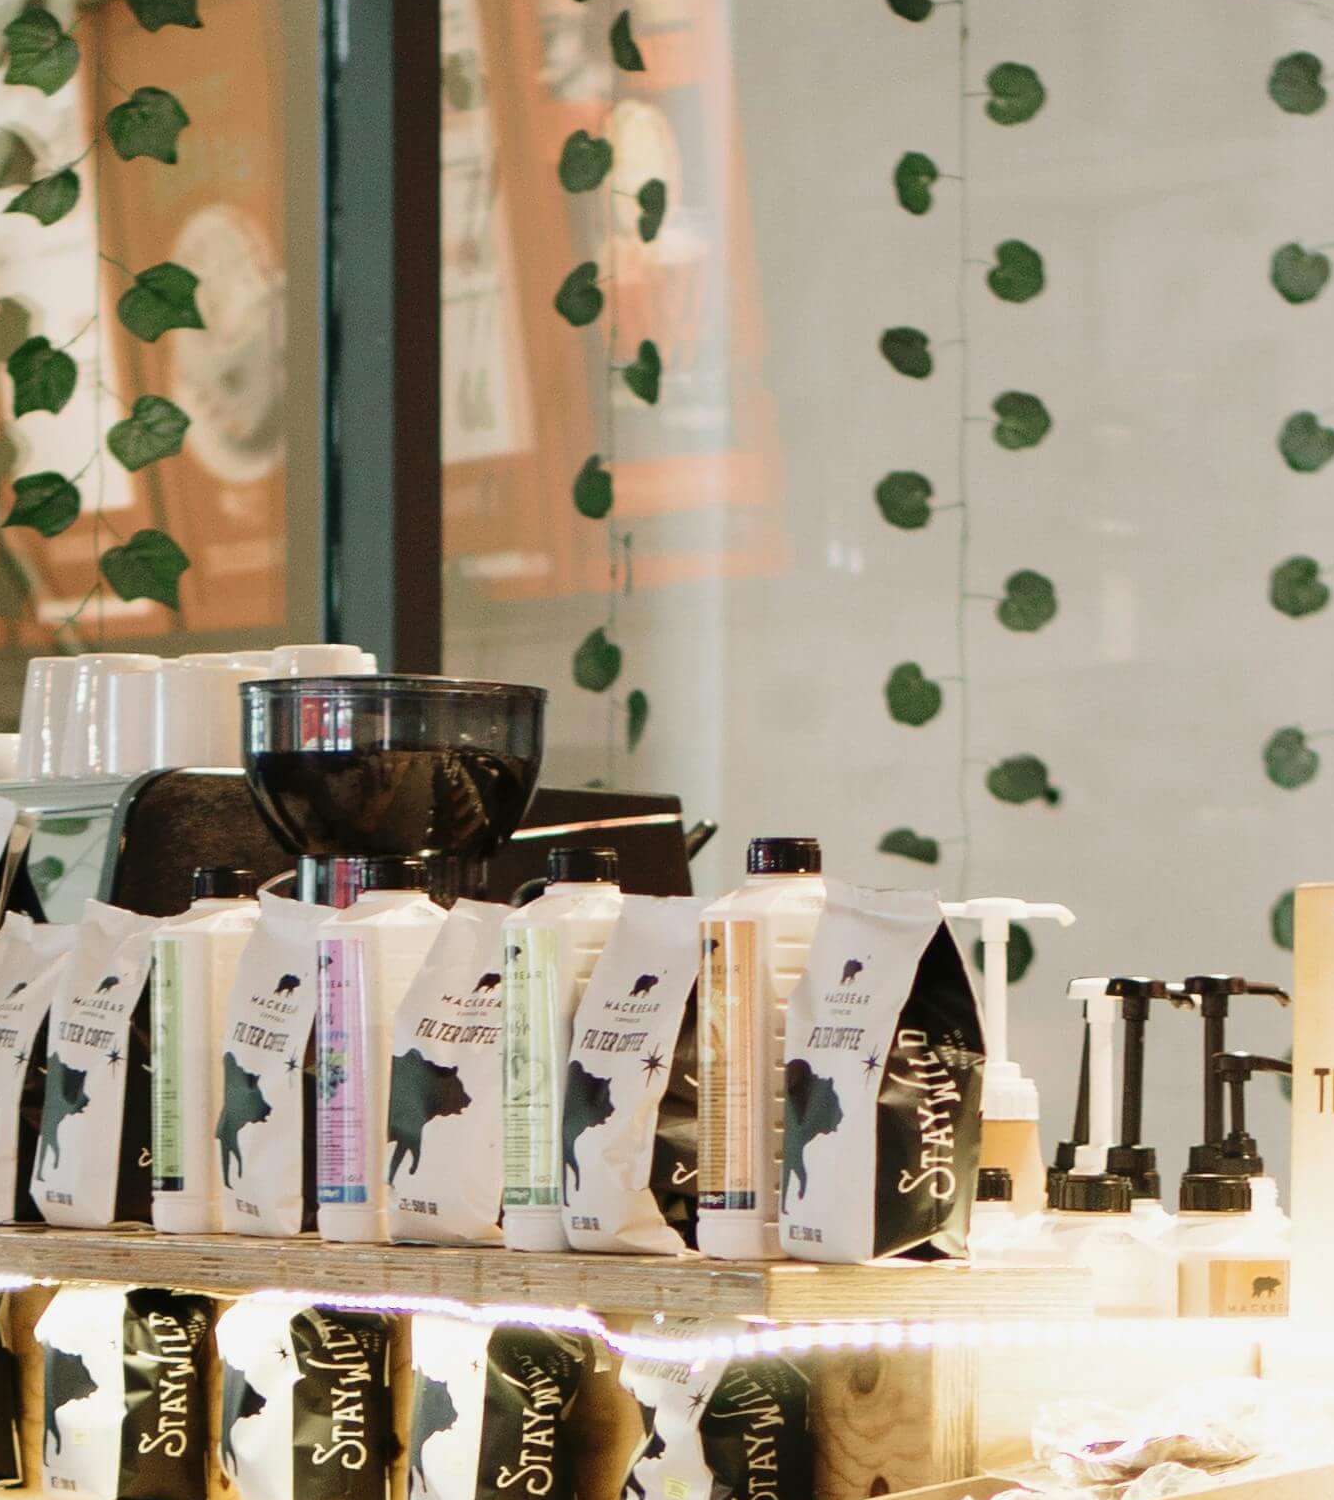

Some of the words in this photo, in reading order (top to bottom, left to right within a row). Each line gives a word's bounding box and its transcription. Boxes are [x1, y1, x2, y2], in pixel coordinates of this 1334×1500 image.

[441, 994, 503, 1009] MACKBEA
[415, 1017, 462, 1044] FILTER
[459, 1025, 503, 1045] COFFEE
[579, 1027, 619, 1052] FILTER
